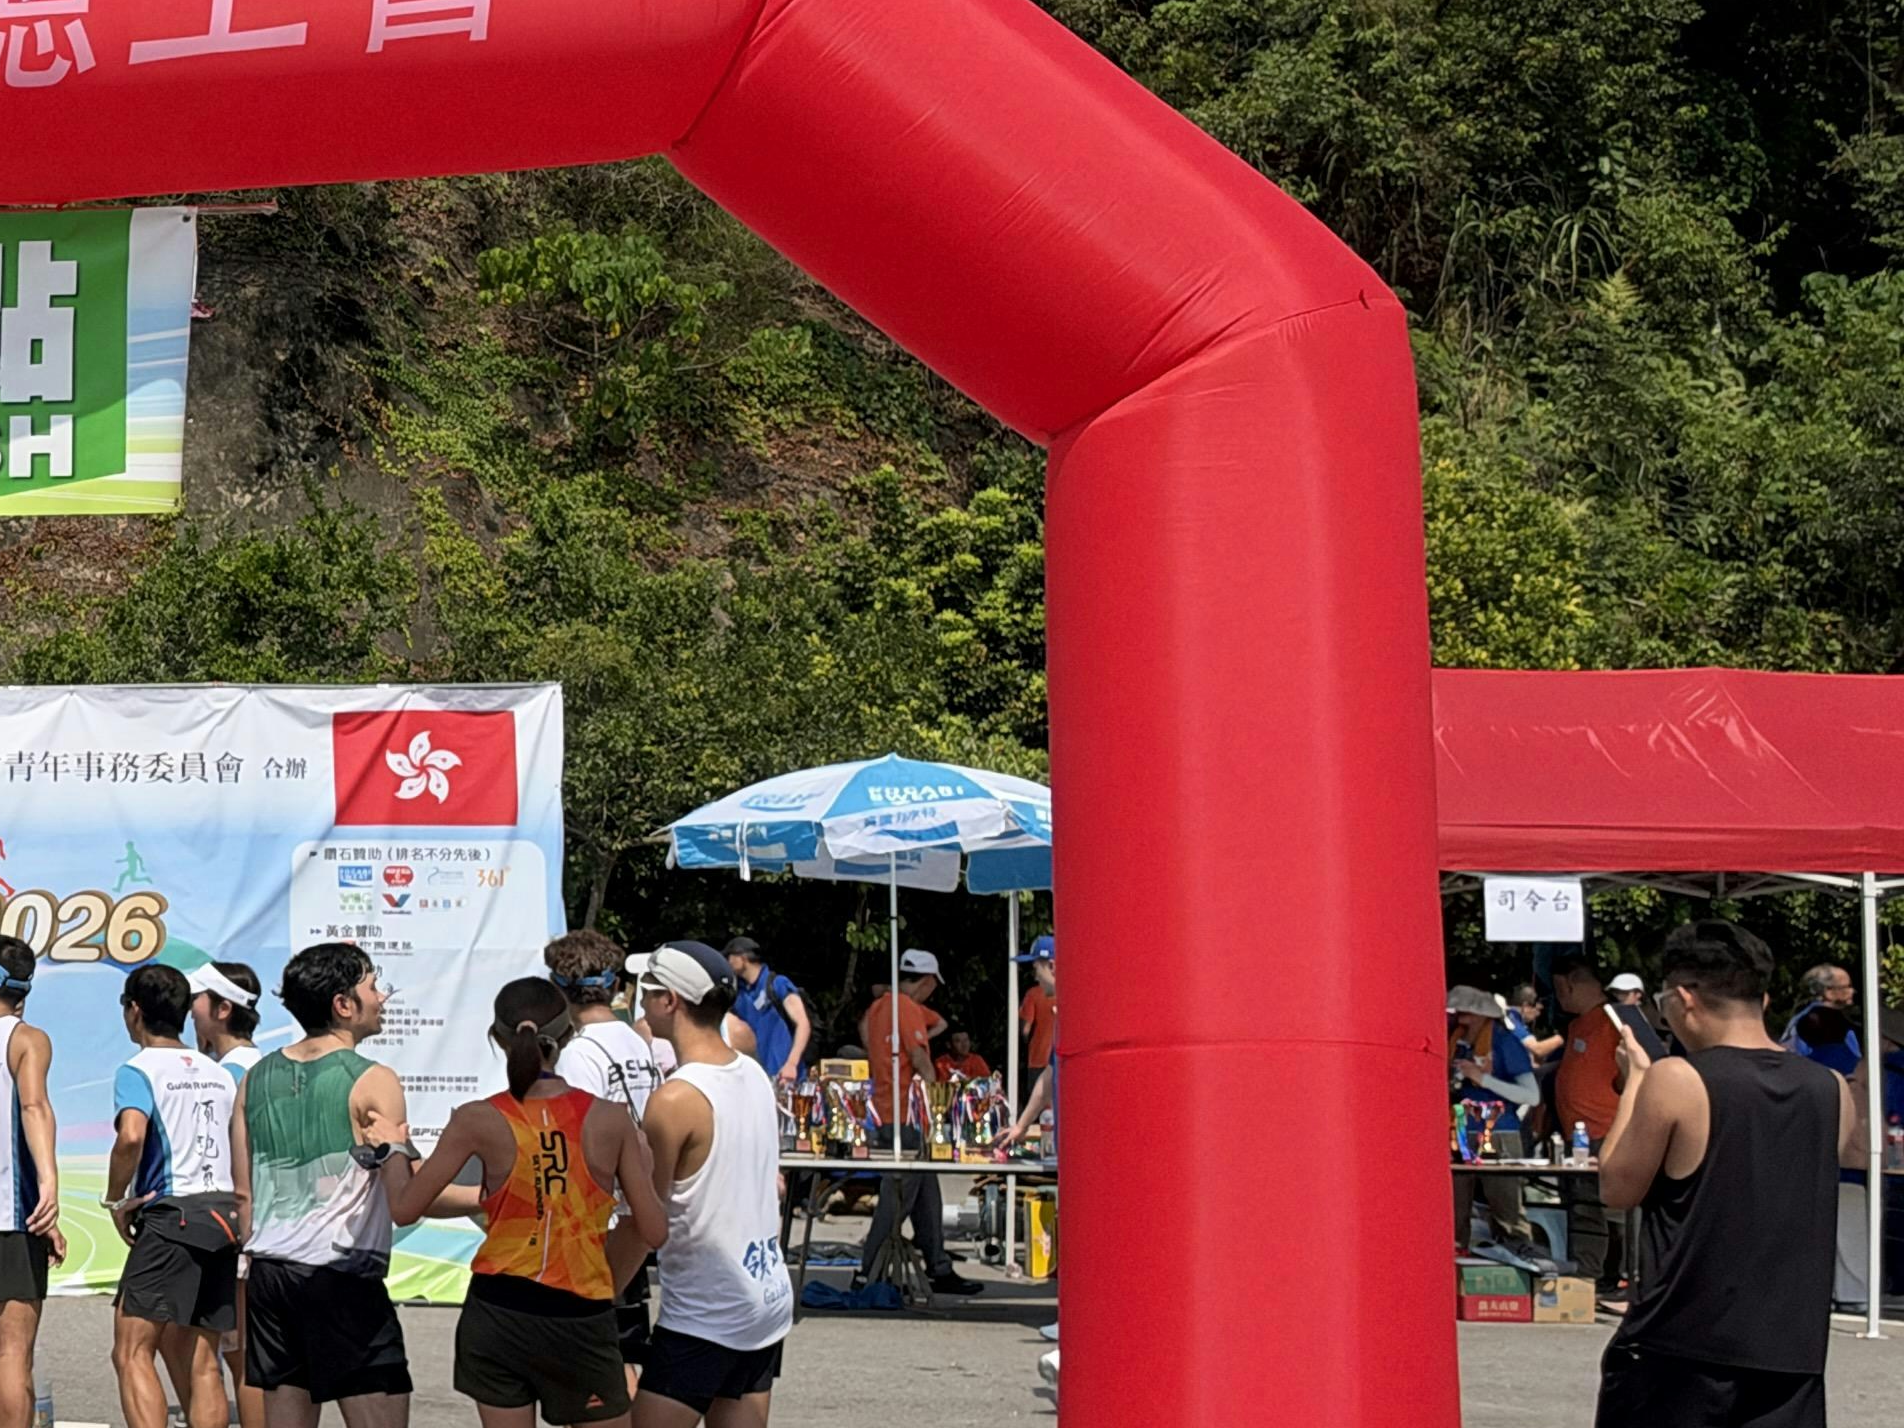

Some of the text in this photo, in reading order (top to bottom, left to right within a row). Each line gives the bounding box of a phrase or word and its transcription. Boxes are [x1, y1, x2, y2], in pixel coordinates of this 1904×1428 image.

[263, 756, 307, 780] 合辦
[1498, 888, 1570, 912] 司令台
[540, 1131, 568, 1196] SRC
